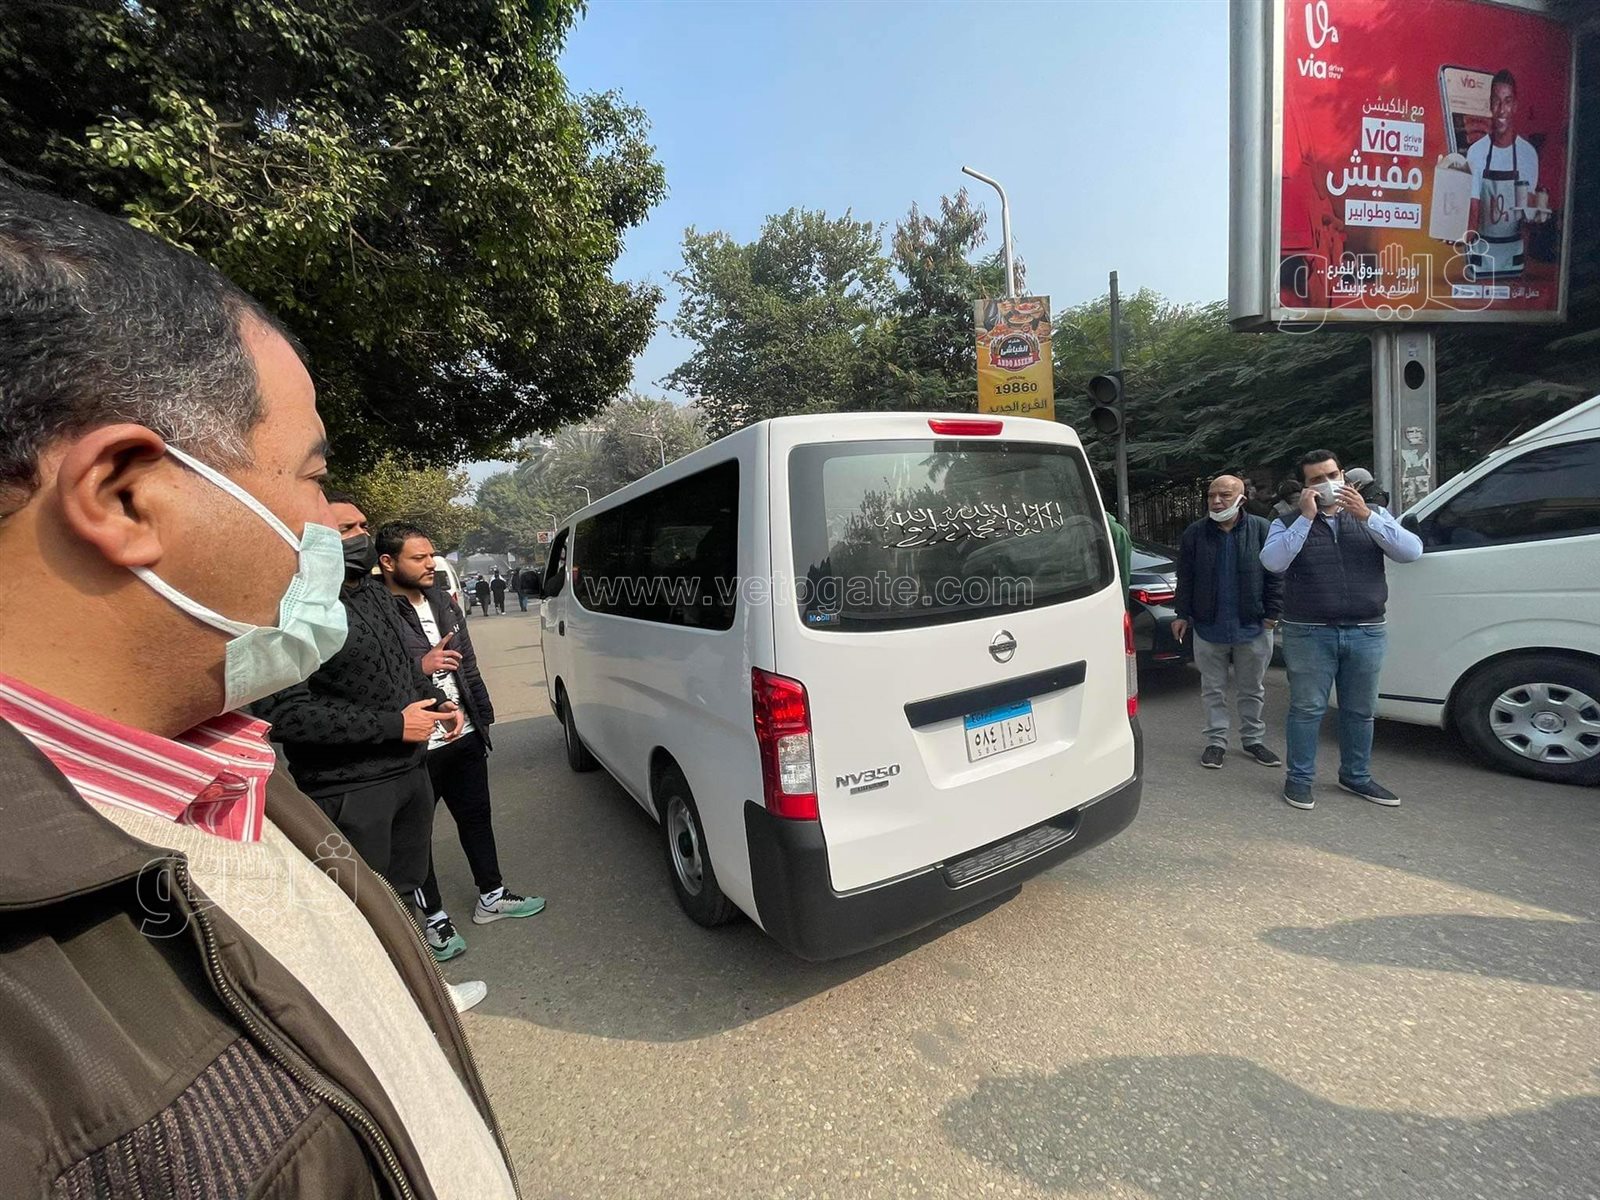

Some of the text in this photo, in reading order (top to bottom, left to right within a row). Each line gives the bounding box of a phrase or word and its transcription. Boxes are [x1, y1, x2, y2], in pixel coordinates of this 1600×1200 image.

[1297, 53, 1327, 79] via
[1363, 96, 1425, 121] مع ابلكيشن
[1365, 121, 1401, 152] via
[1403, 135, 1422, 143] drive
[1403, 143, 1419, 152] thru
[1327, 149, 1423, 197] مفيش
[1348, 203, 1419, 224] زحمة وطوابير
[1326, 260, 1354, 279] للفرع
[1356, 263, 1383, 279] سوق
[1332, 279, 1367, 296] عربيتك
[995, 382, 1038, 395] 19860
[1021, 400, 1047, 413] الفرع
[836, 764, 901, 788] NV350
